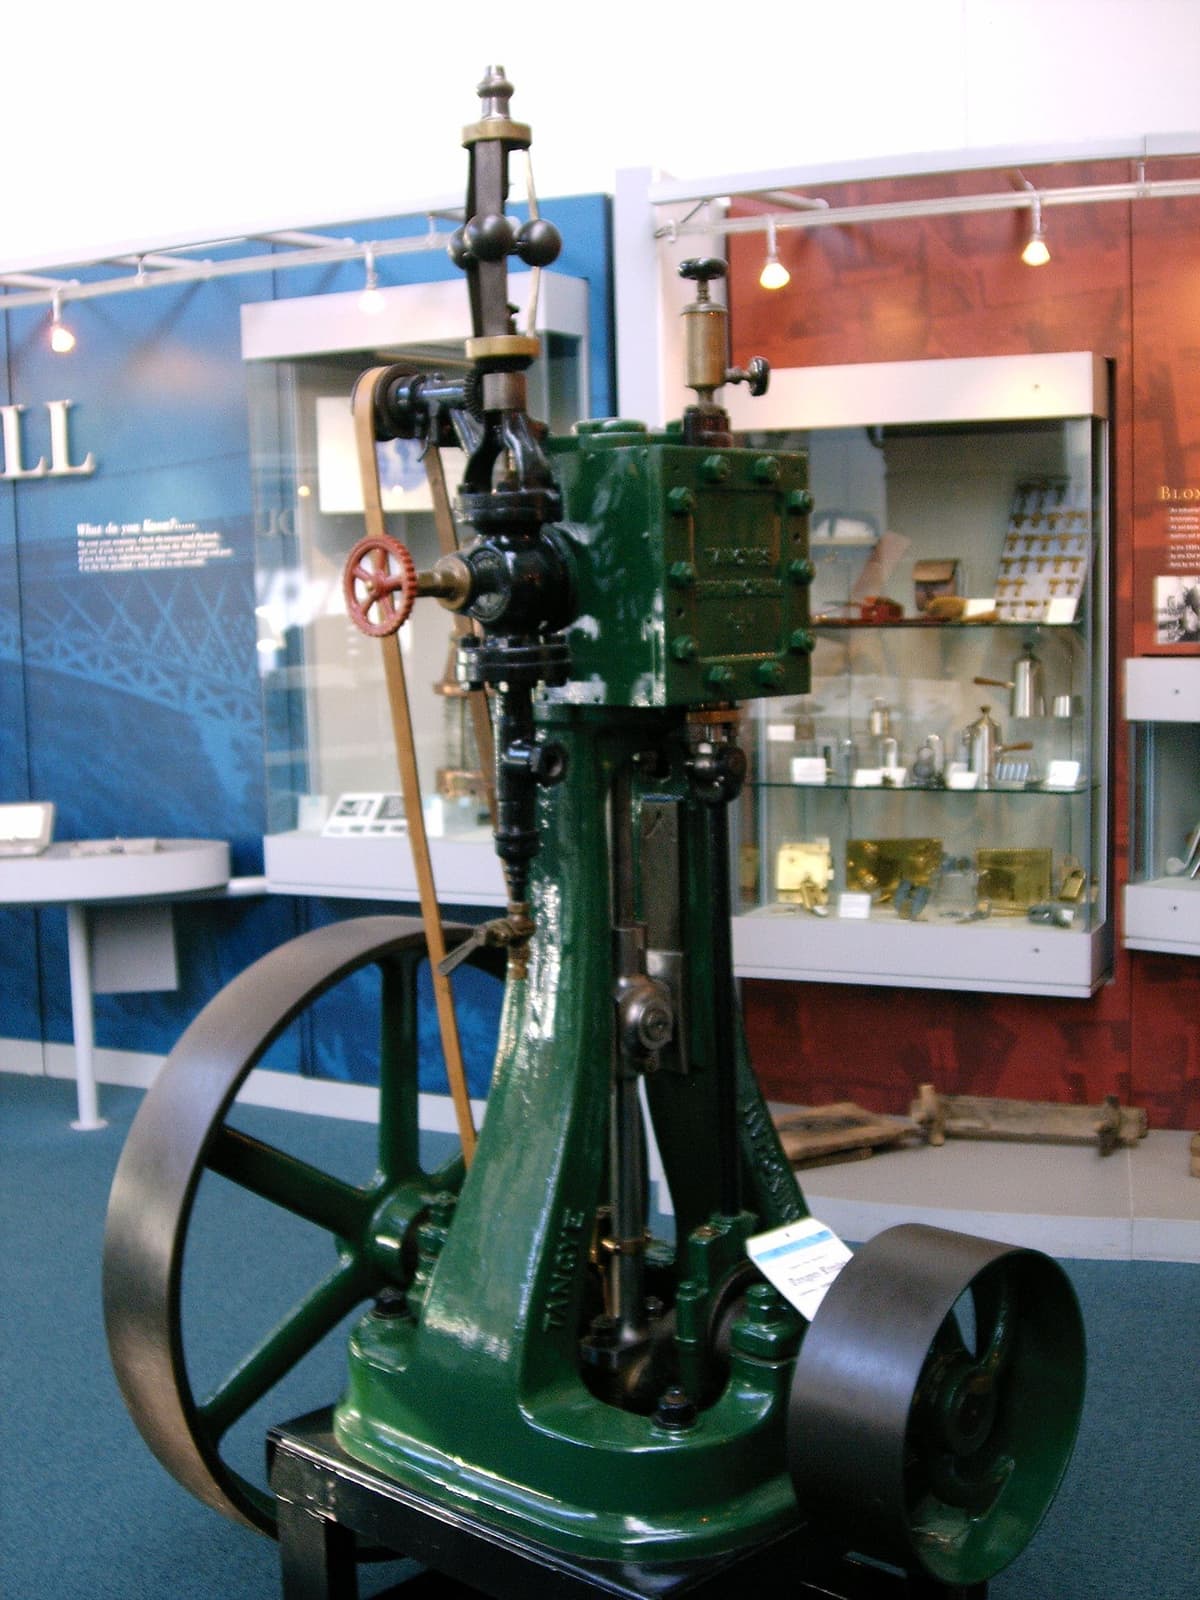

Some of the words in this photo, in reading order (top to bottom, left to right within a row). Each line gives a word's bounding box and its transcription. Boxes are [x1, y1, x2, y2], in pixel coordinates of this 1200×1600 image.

[77, 523, 101, 536] What
[105, 522, 118, 534] do
[120, 523, 140, 535] you
[542, 1209, 585, 1332] TANGYE
